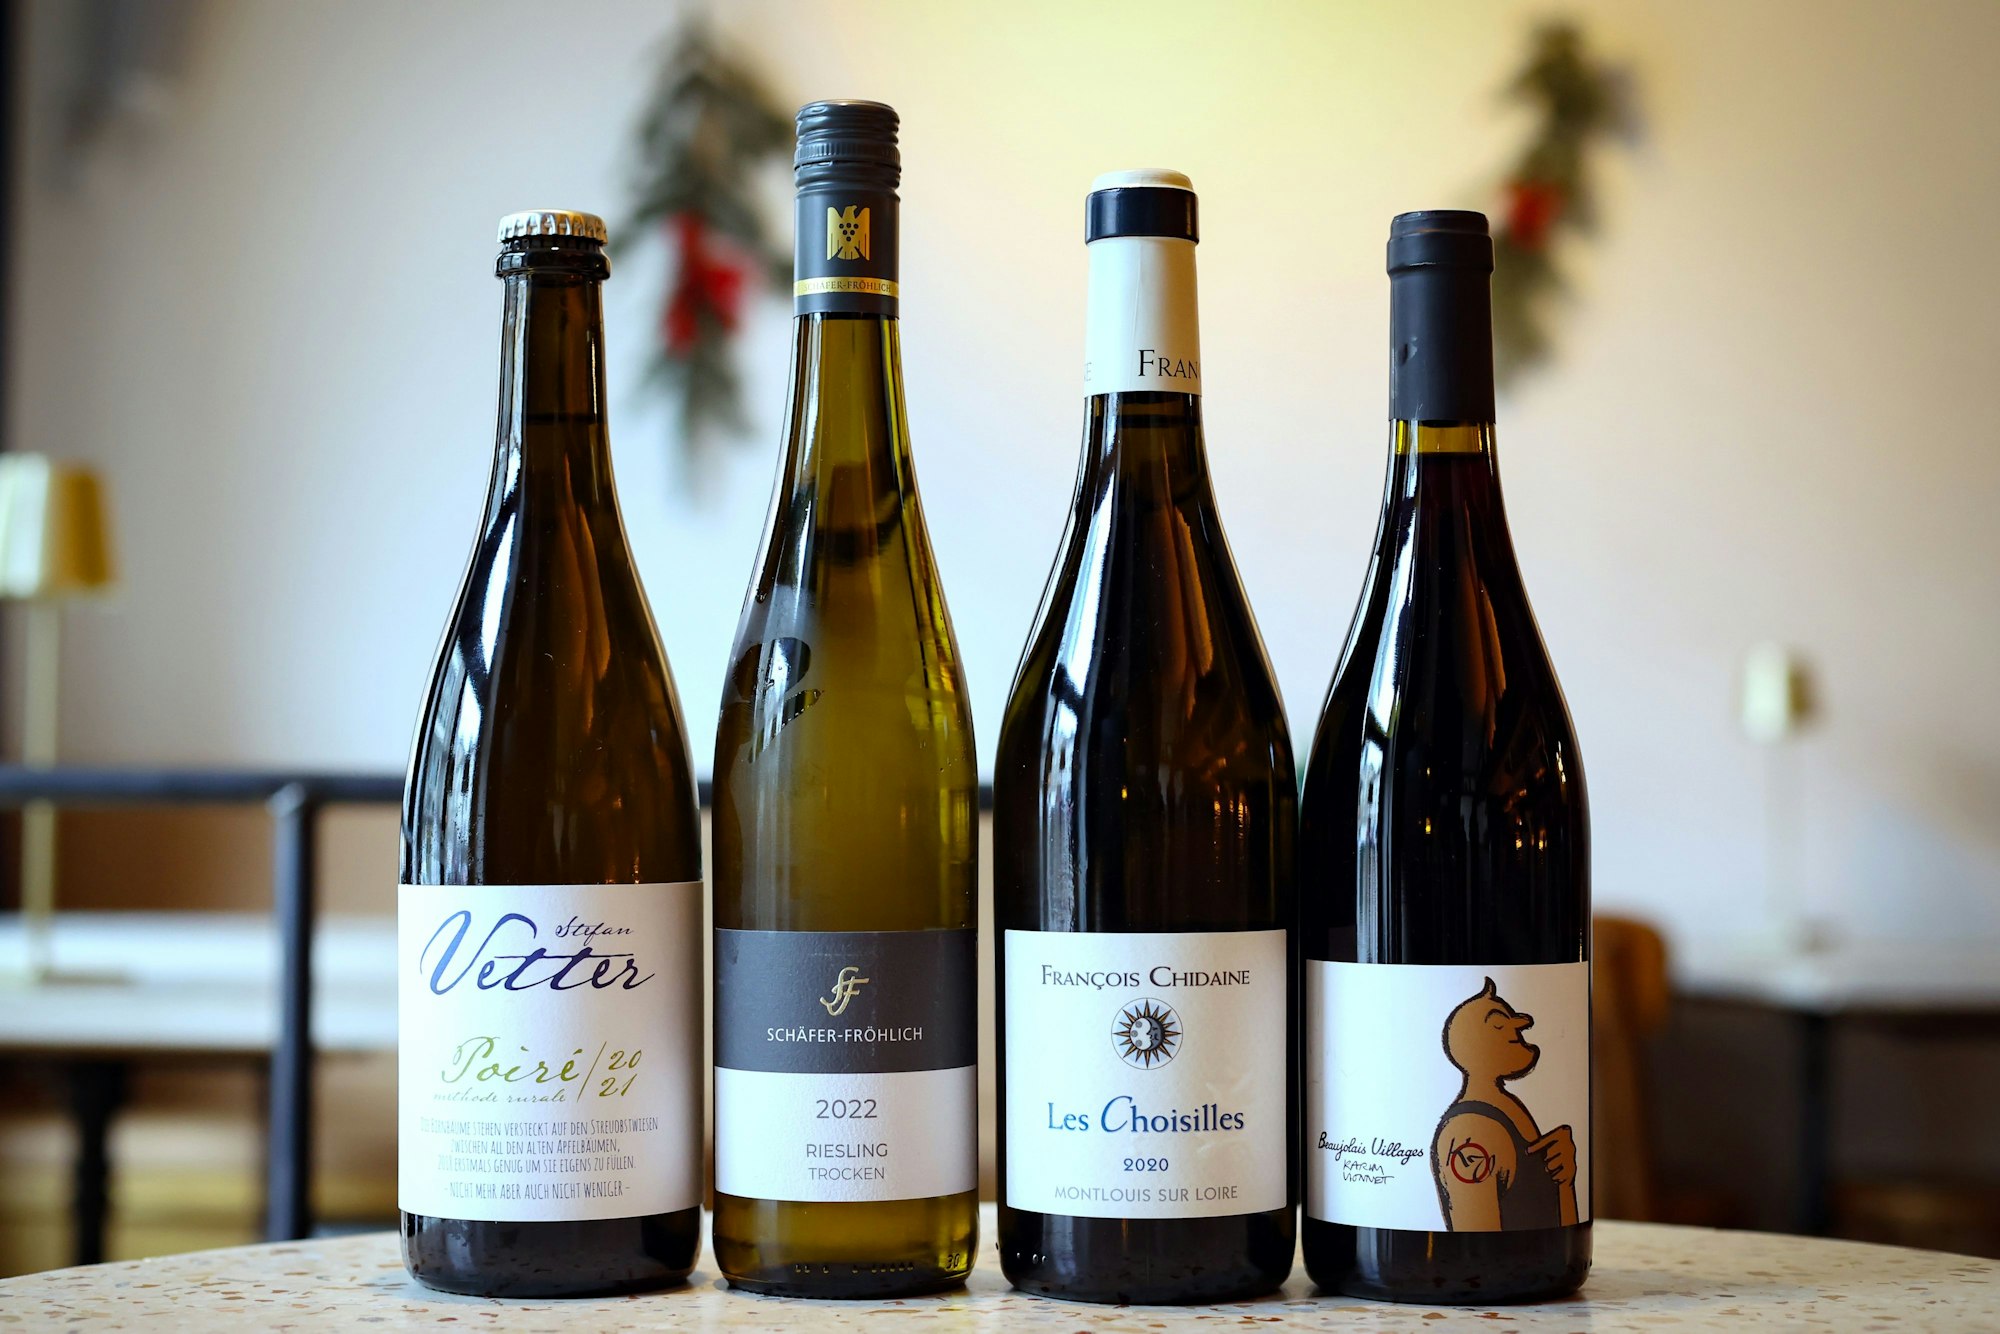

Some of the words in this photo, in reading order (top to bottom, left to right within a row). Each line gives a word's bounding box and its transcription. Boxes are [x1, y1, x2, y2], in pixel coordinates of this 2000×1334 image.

[555, 916, 634, 946] Stefan
[420, 910, 655, 995] Vetter
[1041, 964, 1140, 990] FRANÇOIS
[1149, 966, 1250, 987] CHIDAINE
[767, 1026, 923, 1043] SCHÄFER-FRÖHLICH
[441, 1036, 584, 1084] Poiré
[816, 1099, 878, 1119] 2022
[1048, 1102, 1089, 1131] Les
[1100, 1095, 1244, 1133] Choisilles
[473, 1121, 501, 1136] STEHEN
[504, 1122, 549, 1136] VERSTECKT
[551, 1121, 568, 1136] AUF
[570, 1121, 588, 1136] DEN
[491, 1140, 503, 1155] ALL
[506, 1141, 524, 1155] DEN
[527, 1140, 554, 1155] ALTEN
[806, 1143, 888, 1158] RIESLING
[1318, 1131, 1367, 1162] Beaujolais
[1371, 1137, 1424, 1166] Villages
[494, 1159, 523, 1173] GENUG
[525, 1159, 541, 1173] UM
[543, 1158, 557, 1173] SIE
[559, 1158, 592, 1173] EIGENS
[594, 1157, 605, 1172] ZU
[808, 1167, 885, 1180] TROCKEN
[1123, 1158, 1169, 1172] 2020
[450, 1182, 473, 1198] NICHT
[475, 1183, 498, 1199] MEHR
[500, 1183, 522, 1200] ABER
[524, 1183, 549, 1200] AUCH
[552, 1182, 581, 1199] NICHT
[583, 1180, 623, 1198] WENIGER
[1055, 1186, 1151, 1202] MONTLOUIS
[1158, 1188, 1189, 1202] SUR
[1196, 1185, 1238, 1201] LOIRE
